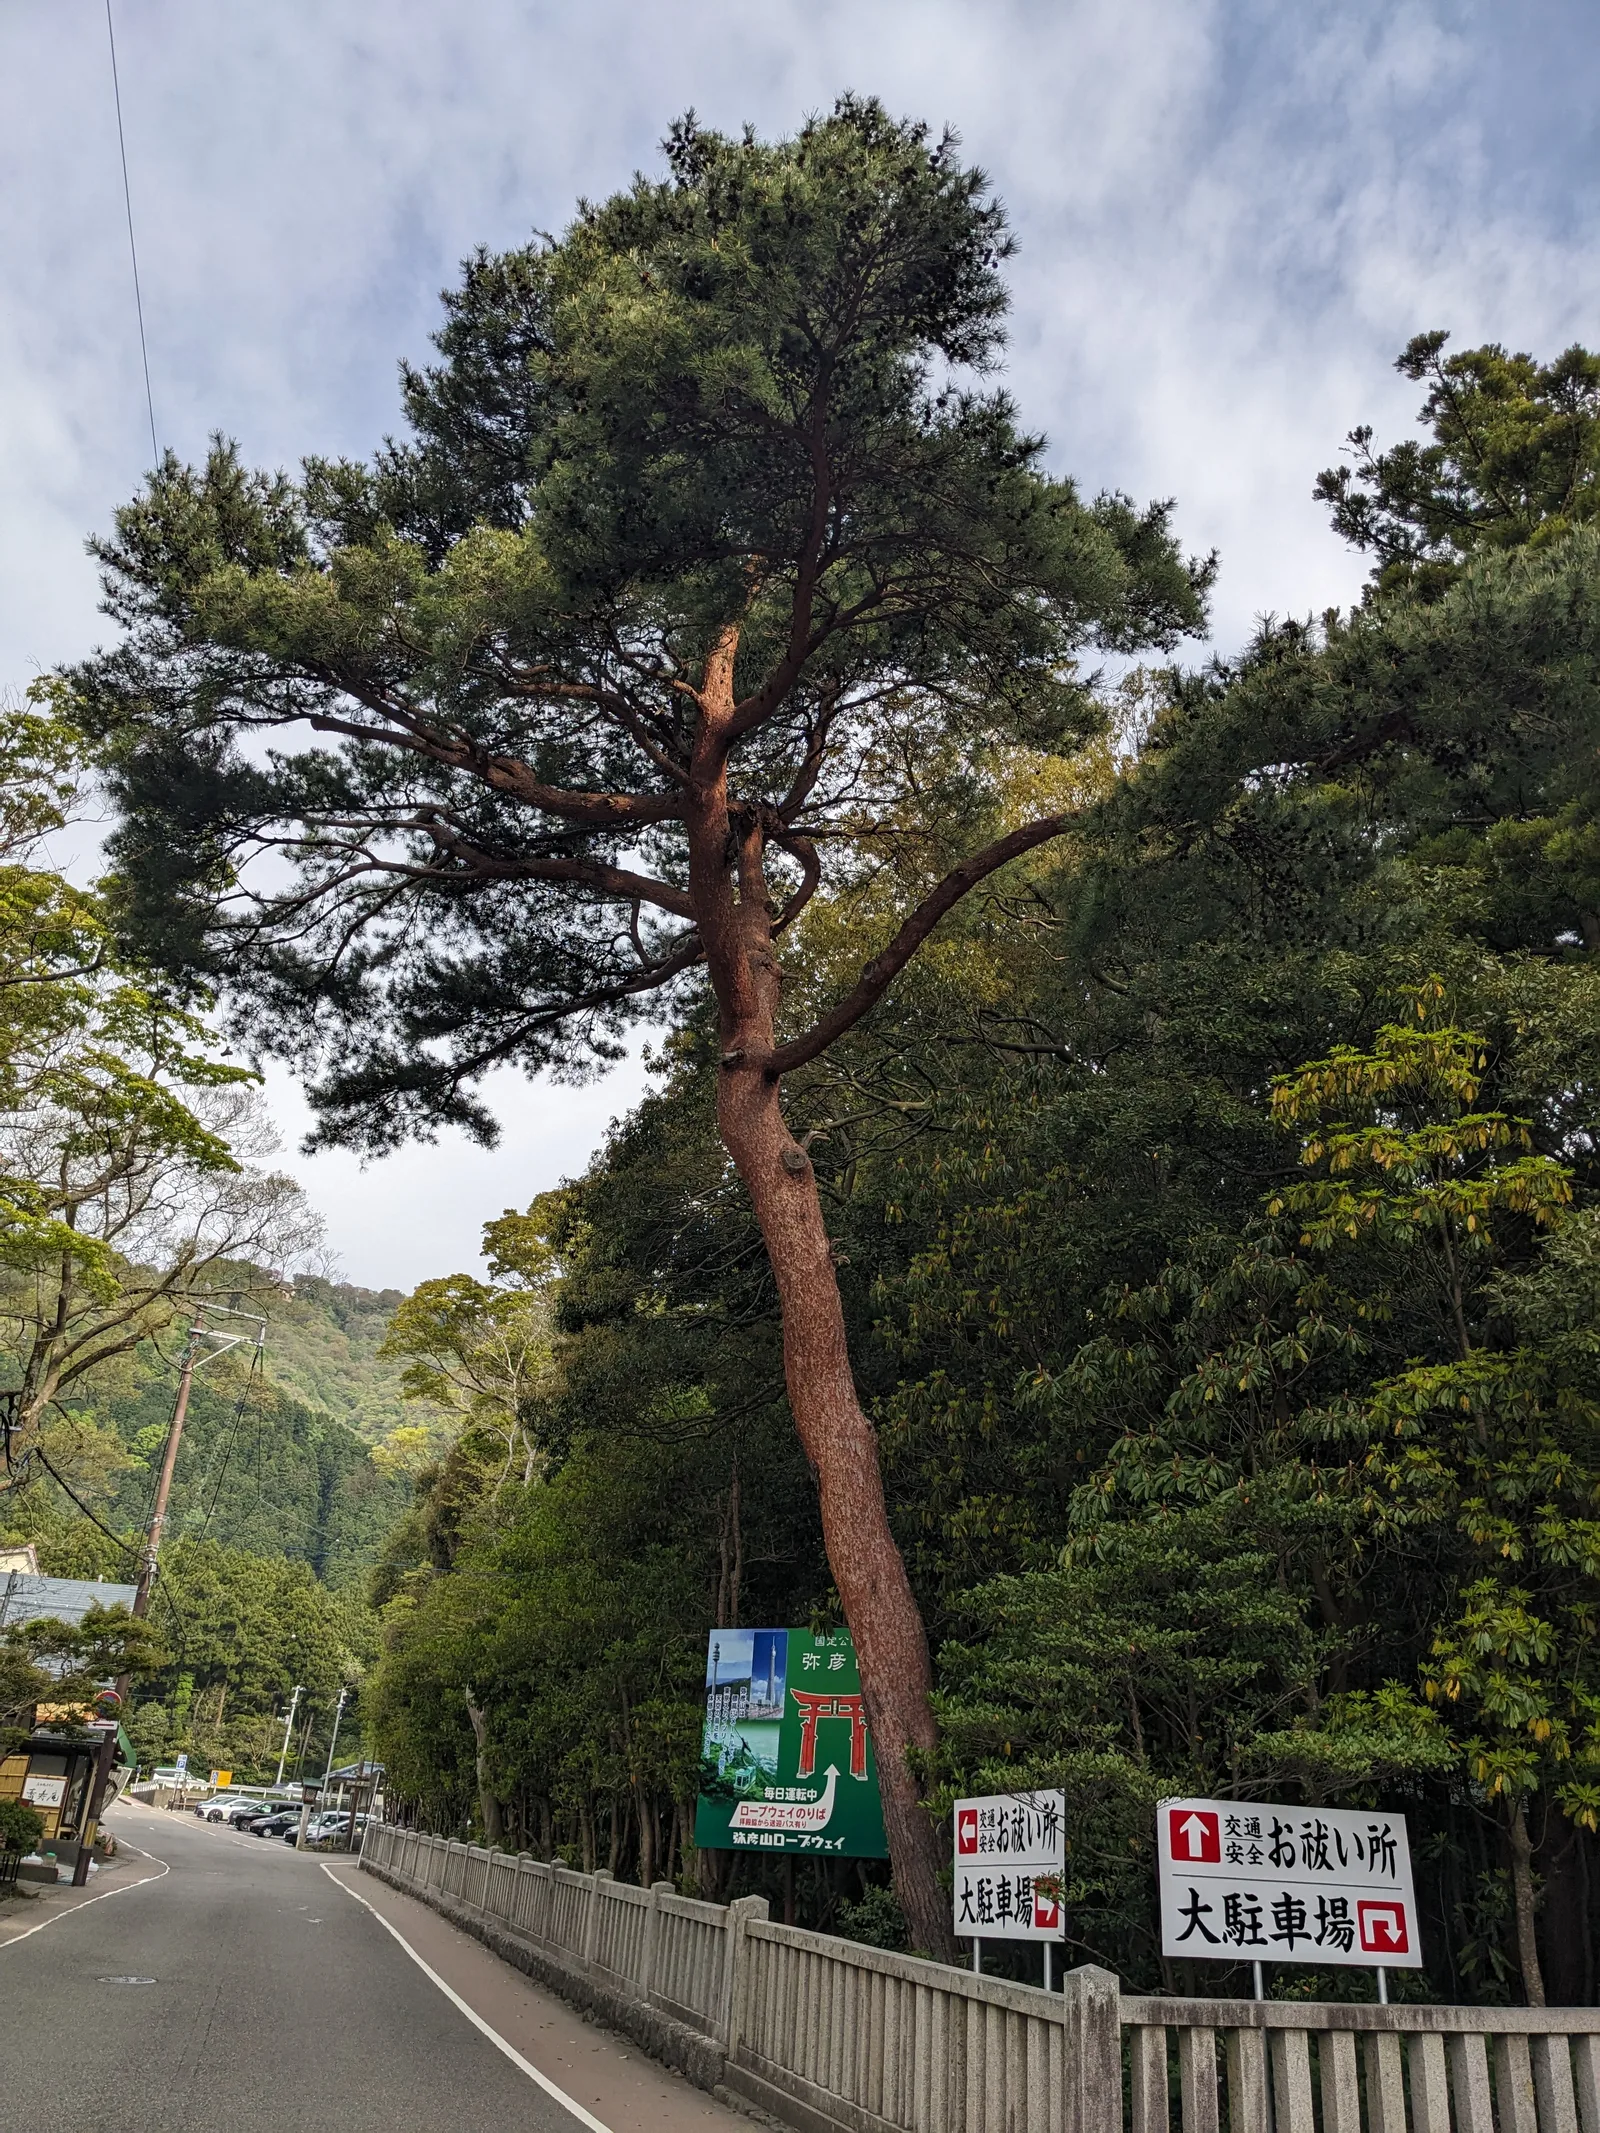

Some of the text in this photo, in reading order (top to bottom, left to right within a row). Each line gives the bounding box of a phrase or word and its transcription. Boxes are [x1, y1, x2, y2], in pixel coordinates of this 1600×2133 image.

[815, 1636, 856, 1647] 国定公
[764, 1787, 818, 1802] 毎日運転中
[740, 1806, 827, 1821] ロープウェイのりば
[979, 1808, 995, 1829] 交通
[996, 1799, 1059, 1855] お祓い所
[1224, 1814, 1264, 1839] 交通
[733, 1831, 846, 1850] 弥彦山ロープウェイ
[979, 1832, 996, 1853] 安全
[1267, 1816, 1398, 1880] お祓い所
[1225, 1841, 1265, 1866] 安全
[958, 1873, 1034, 1930] 大駐車場
[1175, 1887, 1356, 1954] 大駐車場
